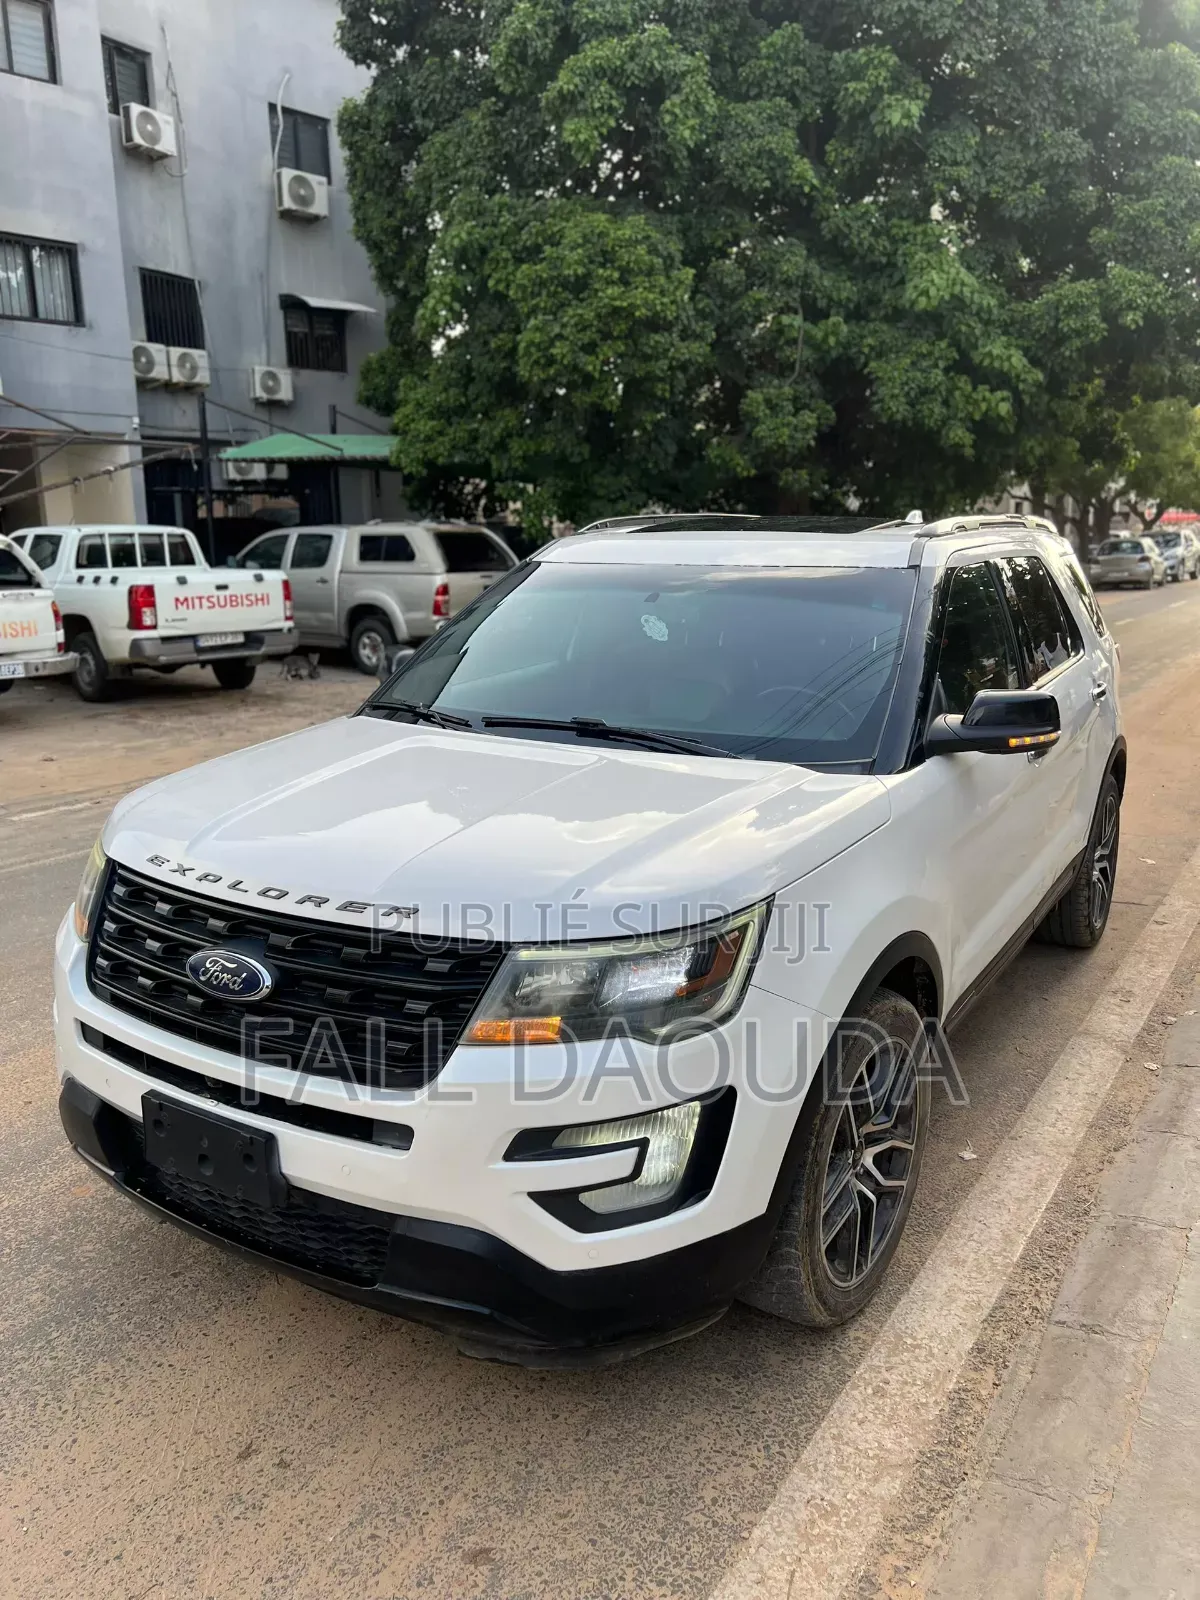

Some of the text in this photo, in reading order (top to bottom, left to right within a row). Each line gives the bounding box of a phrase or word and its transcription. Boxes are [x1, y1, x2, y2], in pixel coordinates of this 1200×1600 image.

[174, 593, 270, 611] MITSUBISHI
[0, 620, 38, 640] ISHI
[146, 855, 419, 918] EXPLORER
[200, 957, 246, 991] Ford
